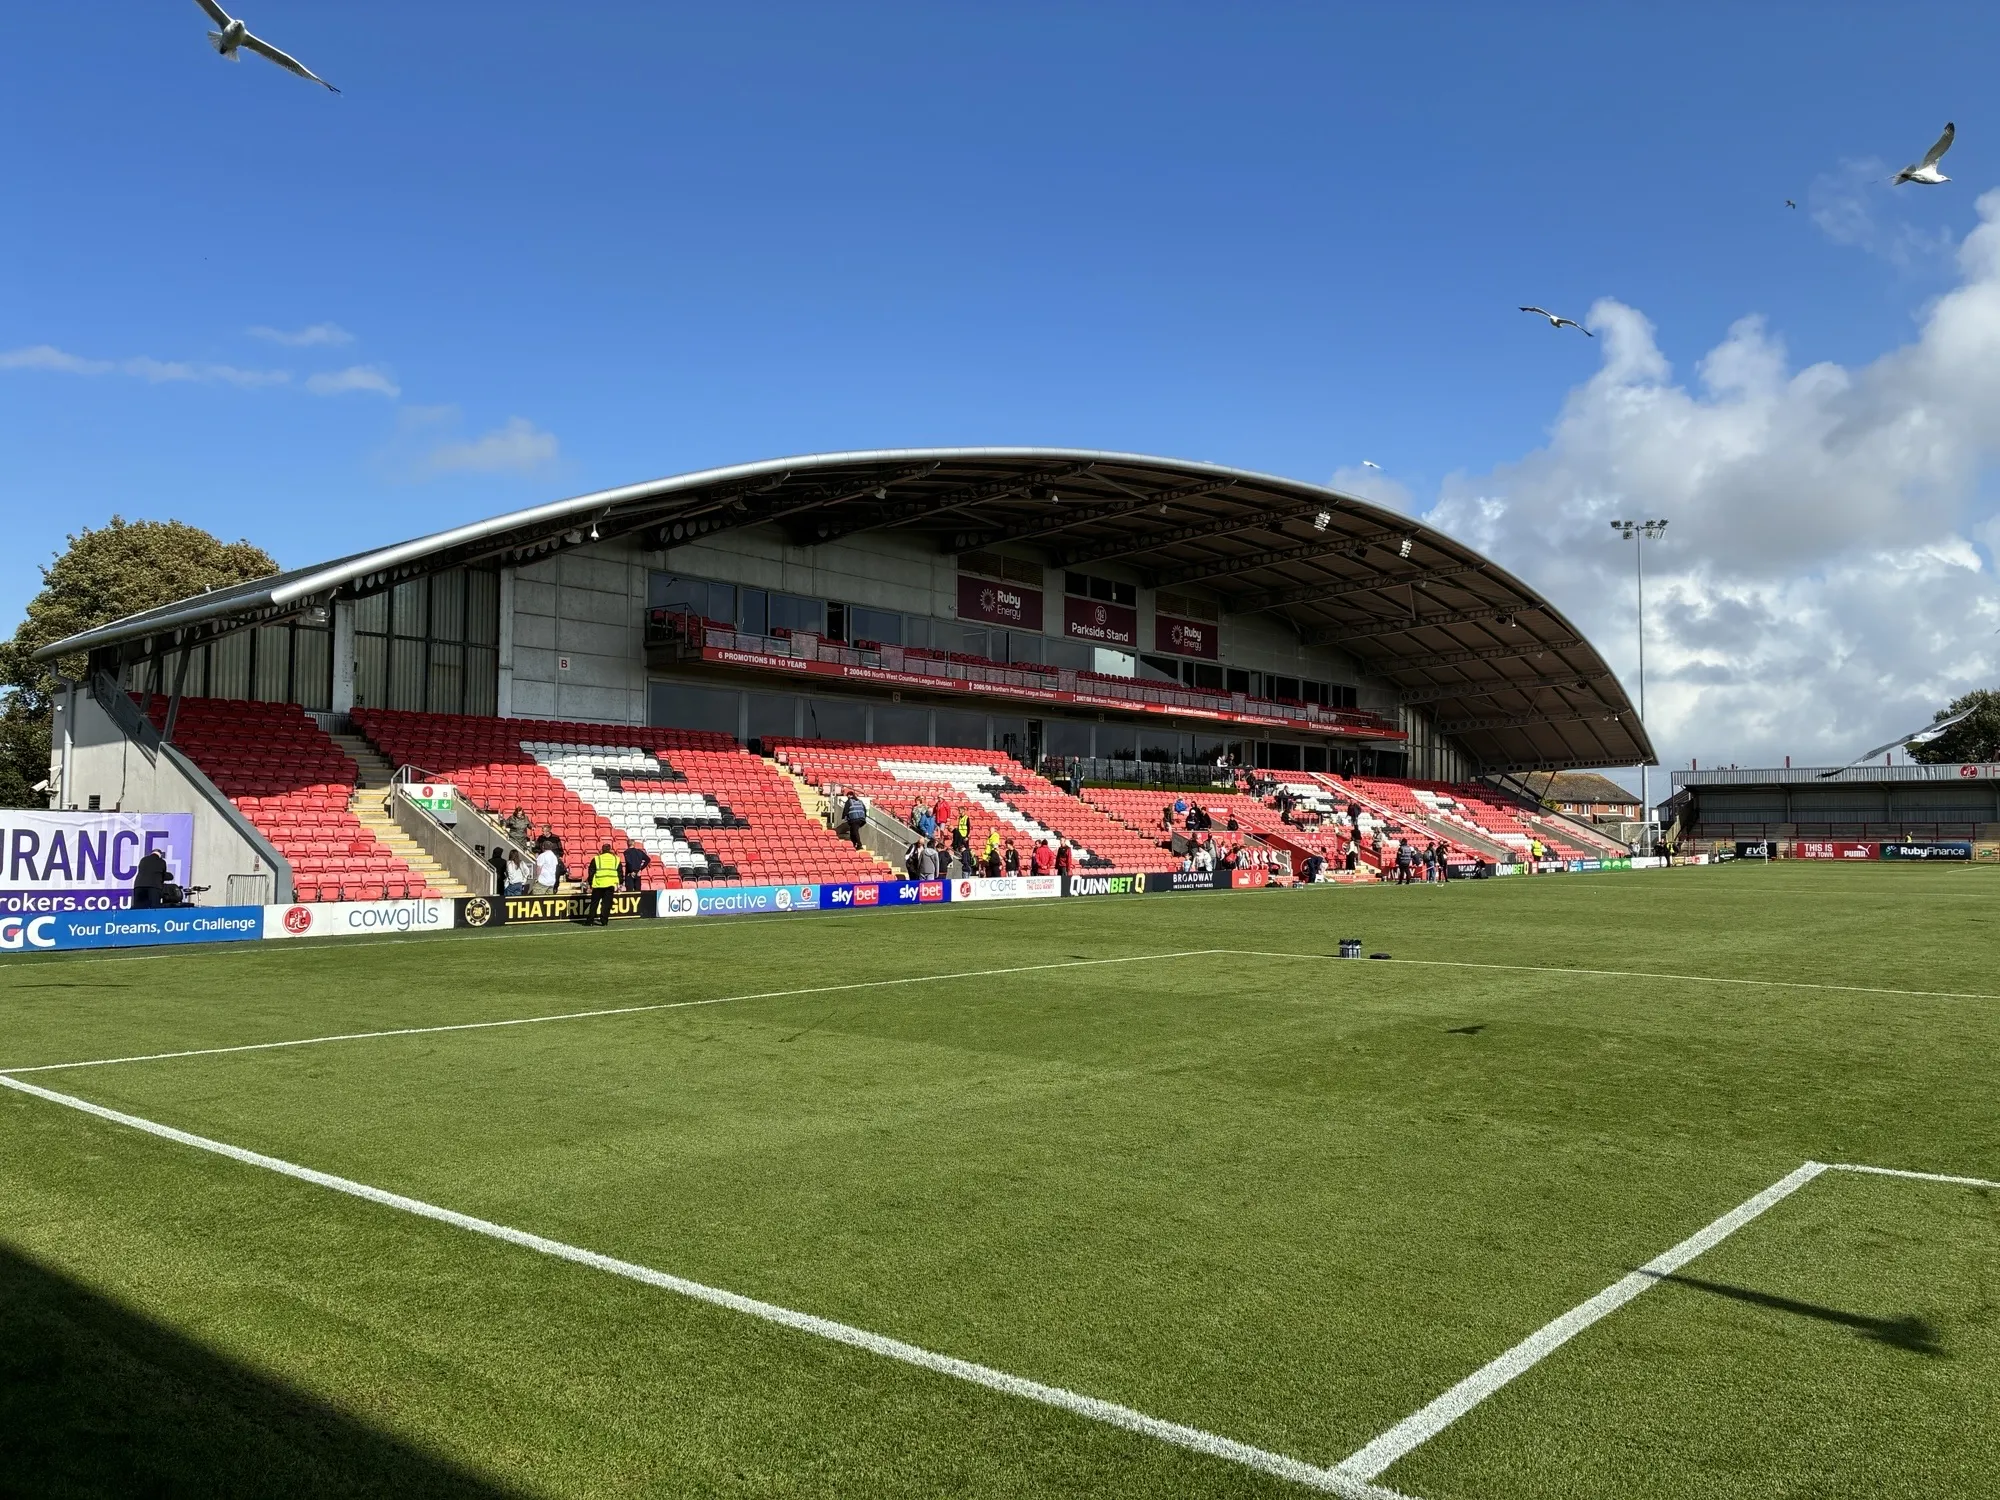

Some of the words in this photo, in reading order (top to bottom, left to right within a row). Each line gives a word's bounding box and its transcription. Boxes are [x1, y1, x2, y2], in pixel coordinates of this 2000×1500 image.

[997, 590, 1021, 609] Ruby
[997, 604, 1021, 621] Energy
[1071, 622, 1105, 638] Parkside
[1106, 628, 1129, 642] Stand
[1183, 626, 1202, 642] Ruby
[1183, 638, 1202, 652] Energy
[561, 659, 568, 668] B
[718, 651, 723, 659] 6
[724, 652, 768, 665] PROMOTIONS
[787, 660, 807, 669] YEARS
[849, 668, 871, 677] 2004/05
[872, 670, 885, 679] North
[886, 672, 898, 680] West
[898, 674, 918, 683] Counties
[919, 677, 935, 686] League
[936, 679, 952, 687] Division
[425, 788, 430, 796] 1
[0, 829, 169, 881] RANC
[1804, 843, 1823, 852] THIS
[1825, 843, 1833, 852] IS
[1900, 847, 1965, 858] RubyFinance
[1070, 875, 1133, 897] QUINNBET
[1172, 873, 1213, 883] BROADWAY
[831, 887, 853, 905] sky
[856, 887, 877, 901] bet
[899, 884, 919, 901] sky
[921, 883, 941, 897] bet
[505, 896, 641, 919] THATPRIZGUY
[668, 895, 693, 912] lab
[700, 893, 767, 911] creative
[349, 902, 439, 932] cowgills
[68, 924, 101, 937] Your
[105, 922, 160, 936] Dreams,
[164, 920, 190, 933] Our
[193, 917, 256, 932] Challenge
